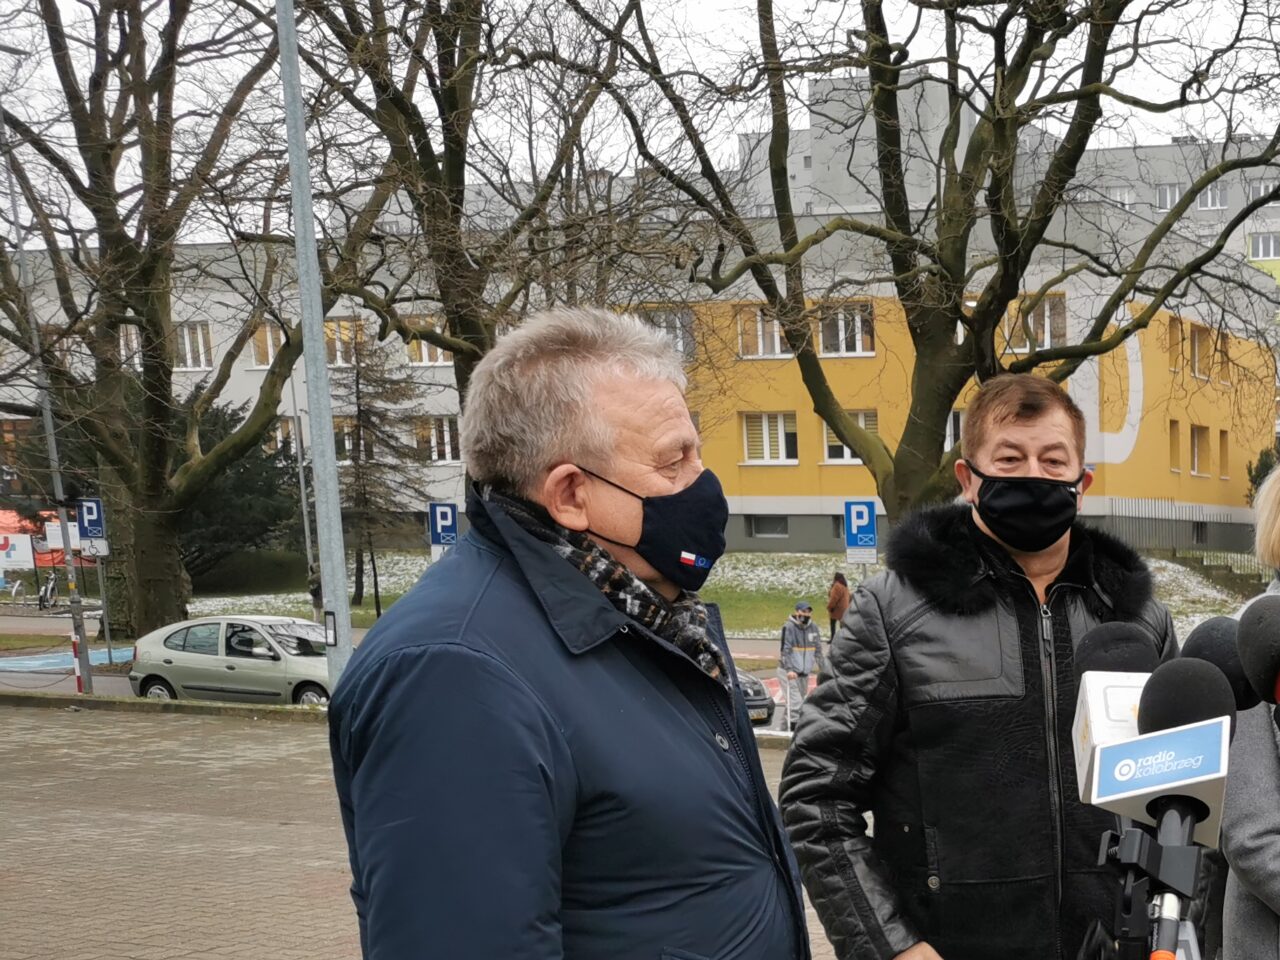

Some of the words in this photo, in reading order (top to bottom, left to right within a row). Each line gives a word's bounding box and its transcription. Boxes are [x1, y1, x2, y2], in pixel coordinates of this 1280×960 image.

[82, 501, 98, 528] P
[436, 506, 453, 533] P
[850, 504, 869, 534] P
[1136, 750, 1176, 767] radio
